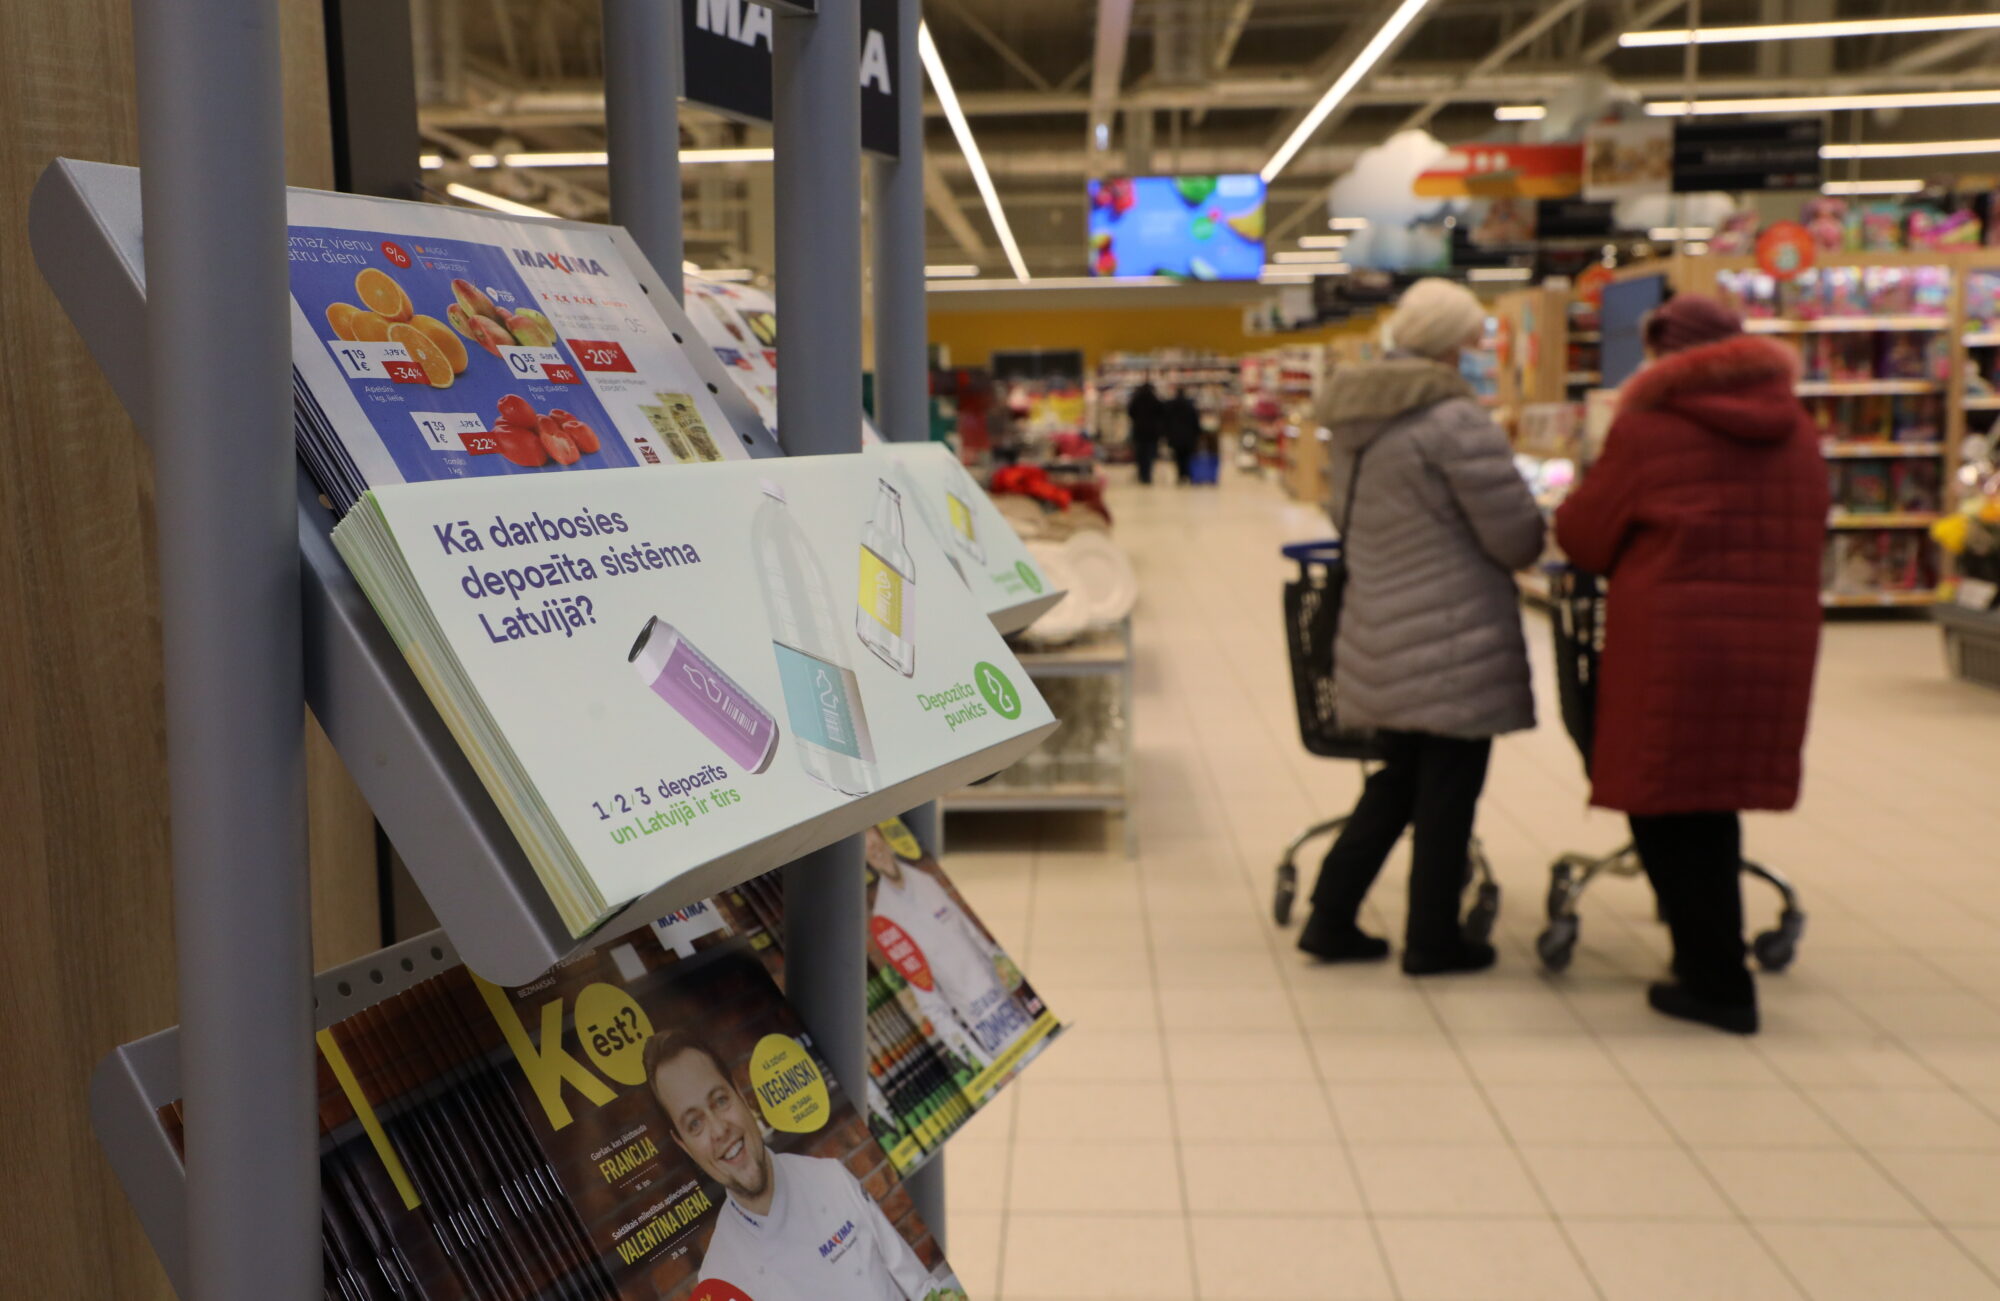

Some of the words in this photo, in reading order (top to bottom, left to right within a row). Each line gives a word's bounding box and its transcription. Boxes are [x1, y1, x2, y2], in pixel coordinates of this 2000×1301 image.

[322, 249, 367, 265] dienu
[329, 237, 374, 251] vienu
[512, 247, 609, 277] MAXIMA
[393, 367, 423, 379] -34%
[551, 369, 574, 380] -41%
[469, 438, 497, 450] -22%
[433, 520, 484, 555] Kā
[489, 506, 629, 548] darbosies
[461, 553, 598, 600] depozīta
[600, 542, 701, 576] sistēma
[478, 595, 597, 644] Latvijā?
[916, 682, 975, 711] Depozīta
[944, 702, 987, 731] punkts
[658, 765, 728, 797] depozīts
[610, 825, 638, 845] un
[635, 800, 696, 835] Latvijā
[692, 796, 709, 815] ir
[710, 788, 741, 808] tīrs
[657, 901, 709, 929] MAXIMA
[587, 1006, 643, 1057] ēst?
[757, 1059, 819, 1108] VEGĀNISKI
[590, 1146, 613, 1161] Garšas,
[598, 1136, 660, 1184] FRANCIJA
[611, 1219, 639, 1241] Saldākais
[616, 1215, 682, 1265] VALENTĪNA
[674, 1185, 713, 1226] DIENĀ
[818, 1220, 855, 1258] MAXIMA
